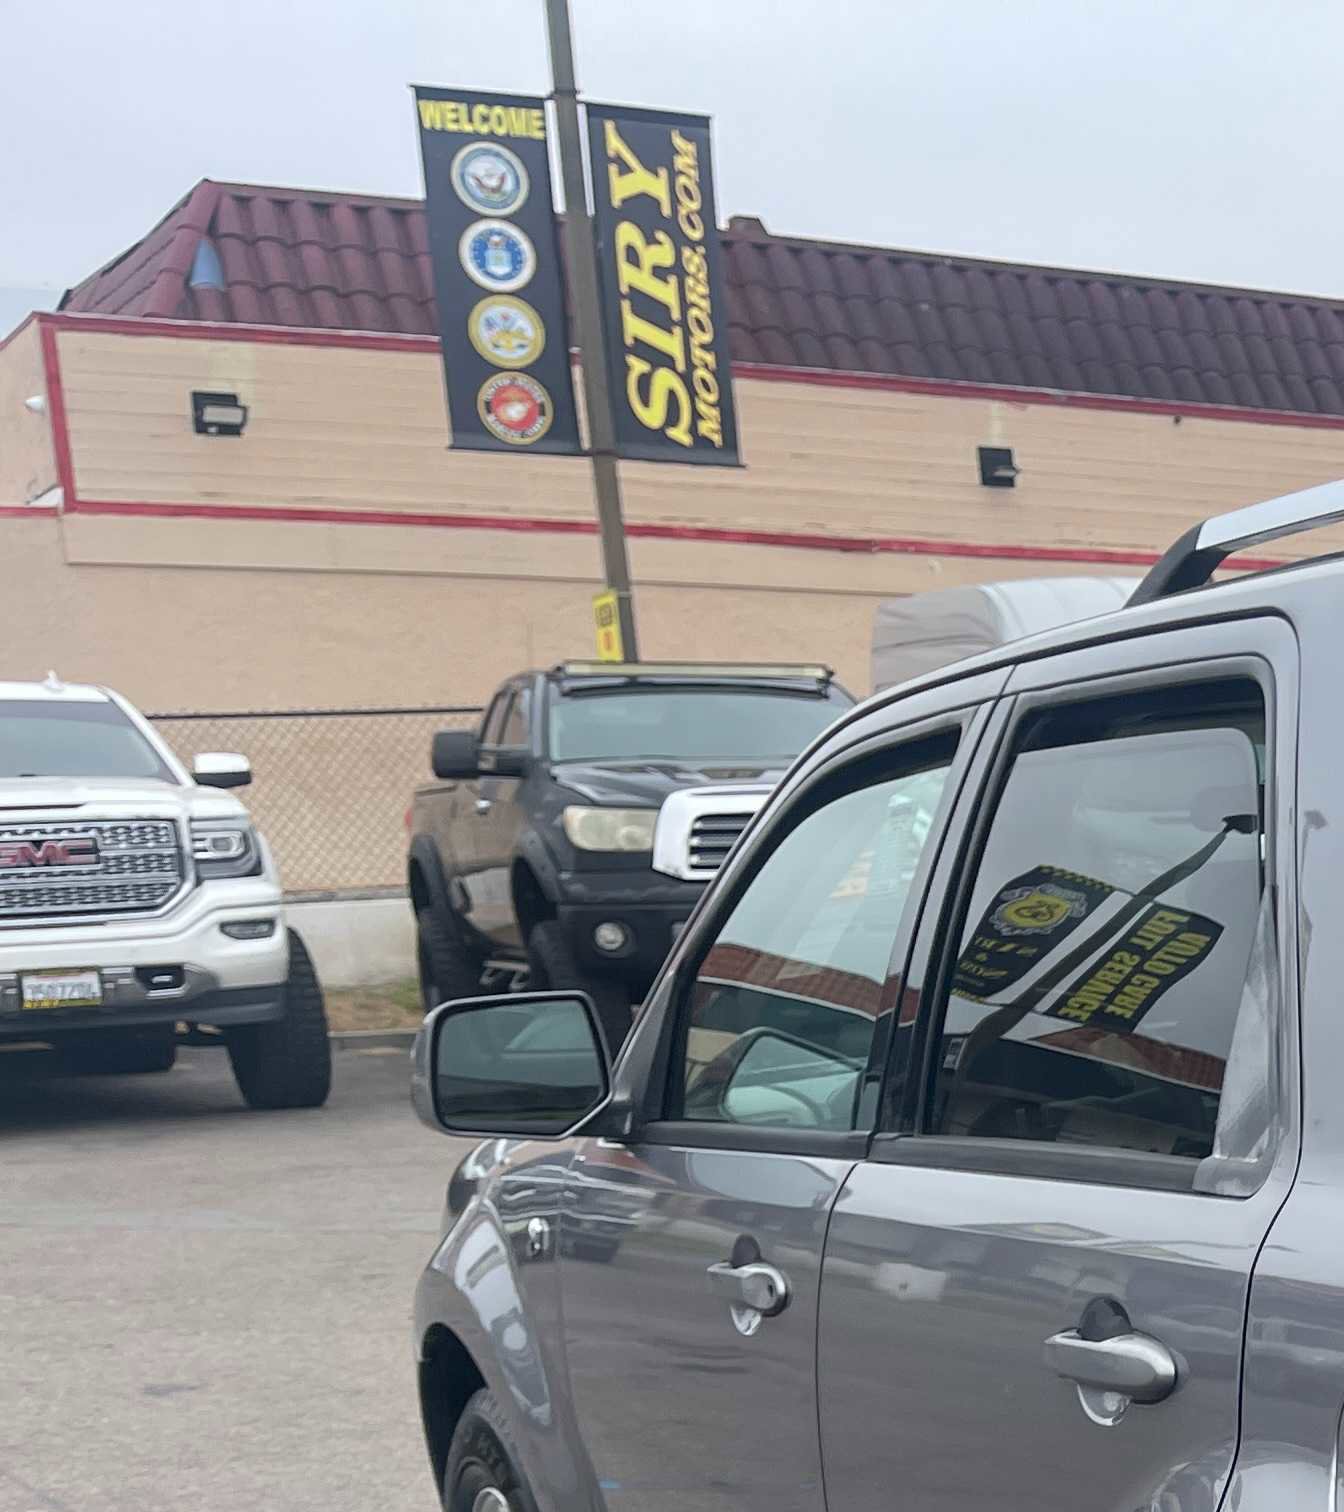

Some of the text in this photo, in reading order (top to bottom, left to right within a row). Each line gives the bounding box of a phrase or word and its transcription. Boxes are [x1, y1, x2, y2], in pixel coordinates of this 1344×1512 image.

[418, 100, 546, 140] WELCOME
[604, 120, 693, 447] SIRY
[671, 129, 723, 448] MOTORS.COM
